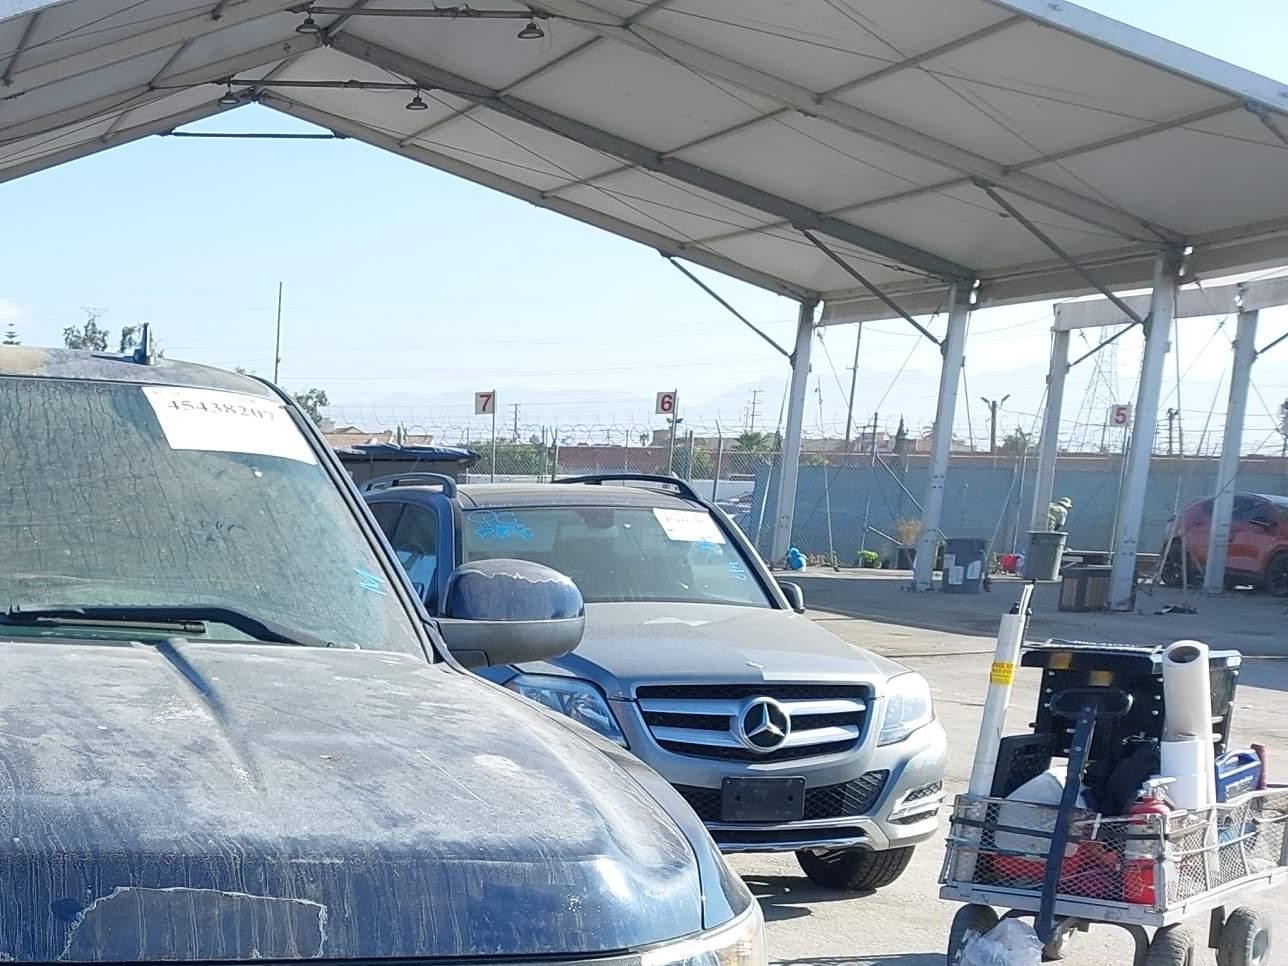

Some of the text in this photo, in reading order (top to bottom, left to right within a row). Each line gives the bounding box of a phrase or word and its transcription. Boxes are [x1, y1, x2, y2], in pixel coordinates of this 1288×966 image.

[479, 394, 492, 412] 7
[661, 394, 673, 412] 6
[1114, 406, 1127, 424] 5
